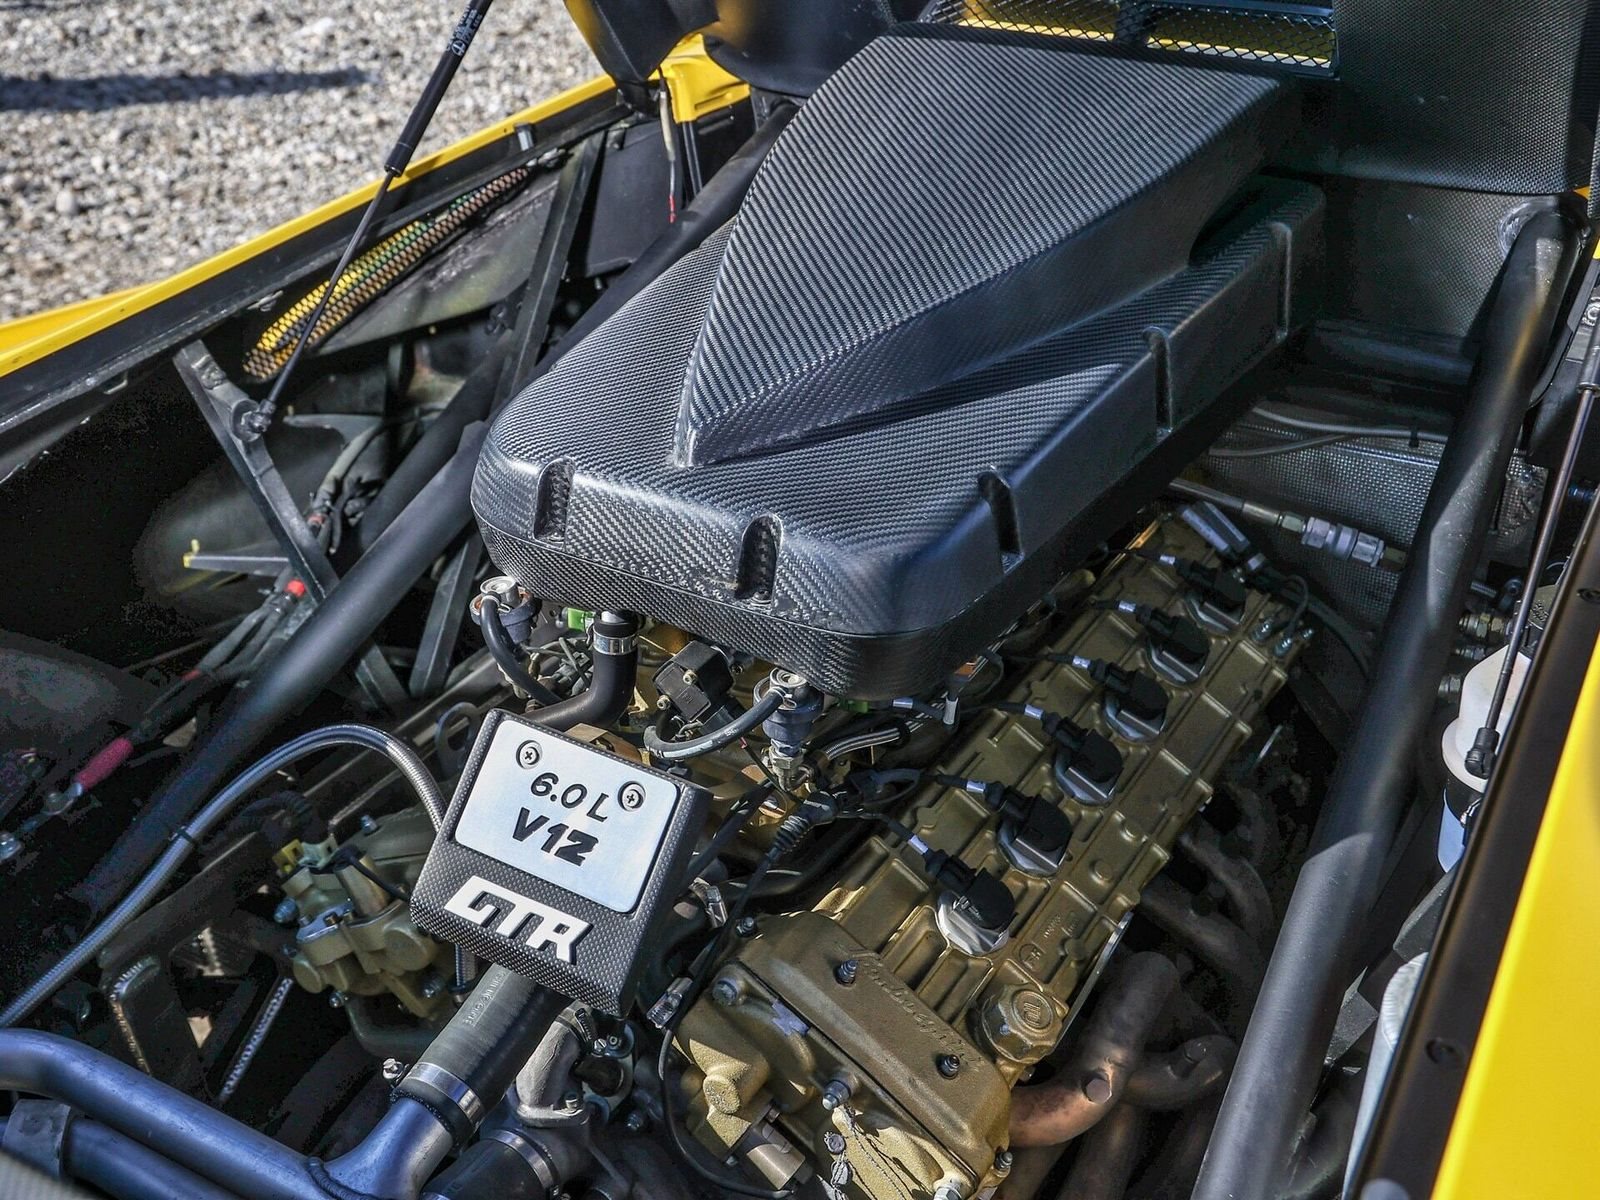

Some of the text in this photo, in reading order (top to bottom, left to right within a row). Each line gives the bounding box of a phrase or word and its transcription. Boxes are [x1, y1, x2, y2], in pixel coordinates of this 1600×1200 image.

[530, 772, 609, 822] 6.0 L
[512, 806, 599, 867] V12
[444, 875, 592, 964] GTR
